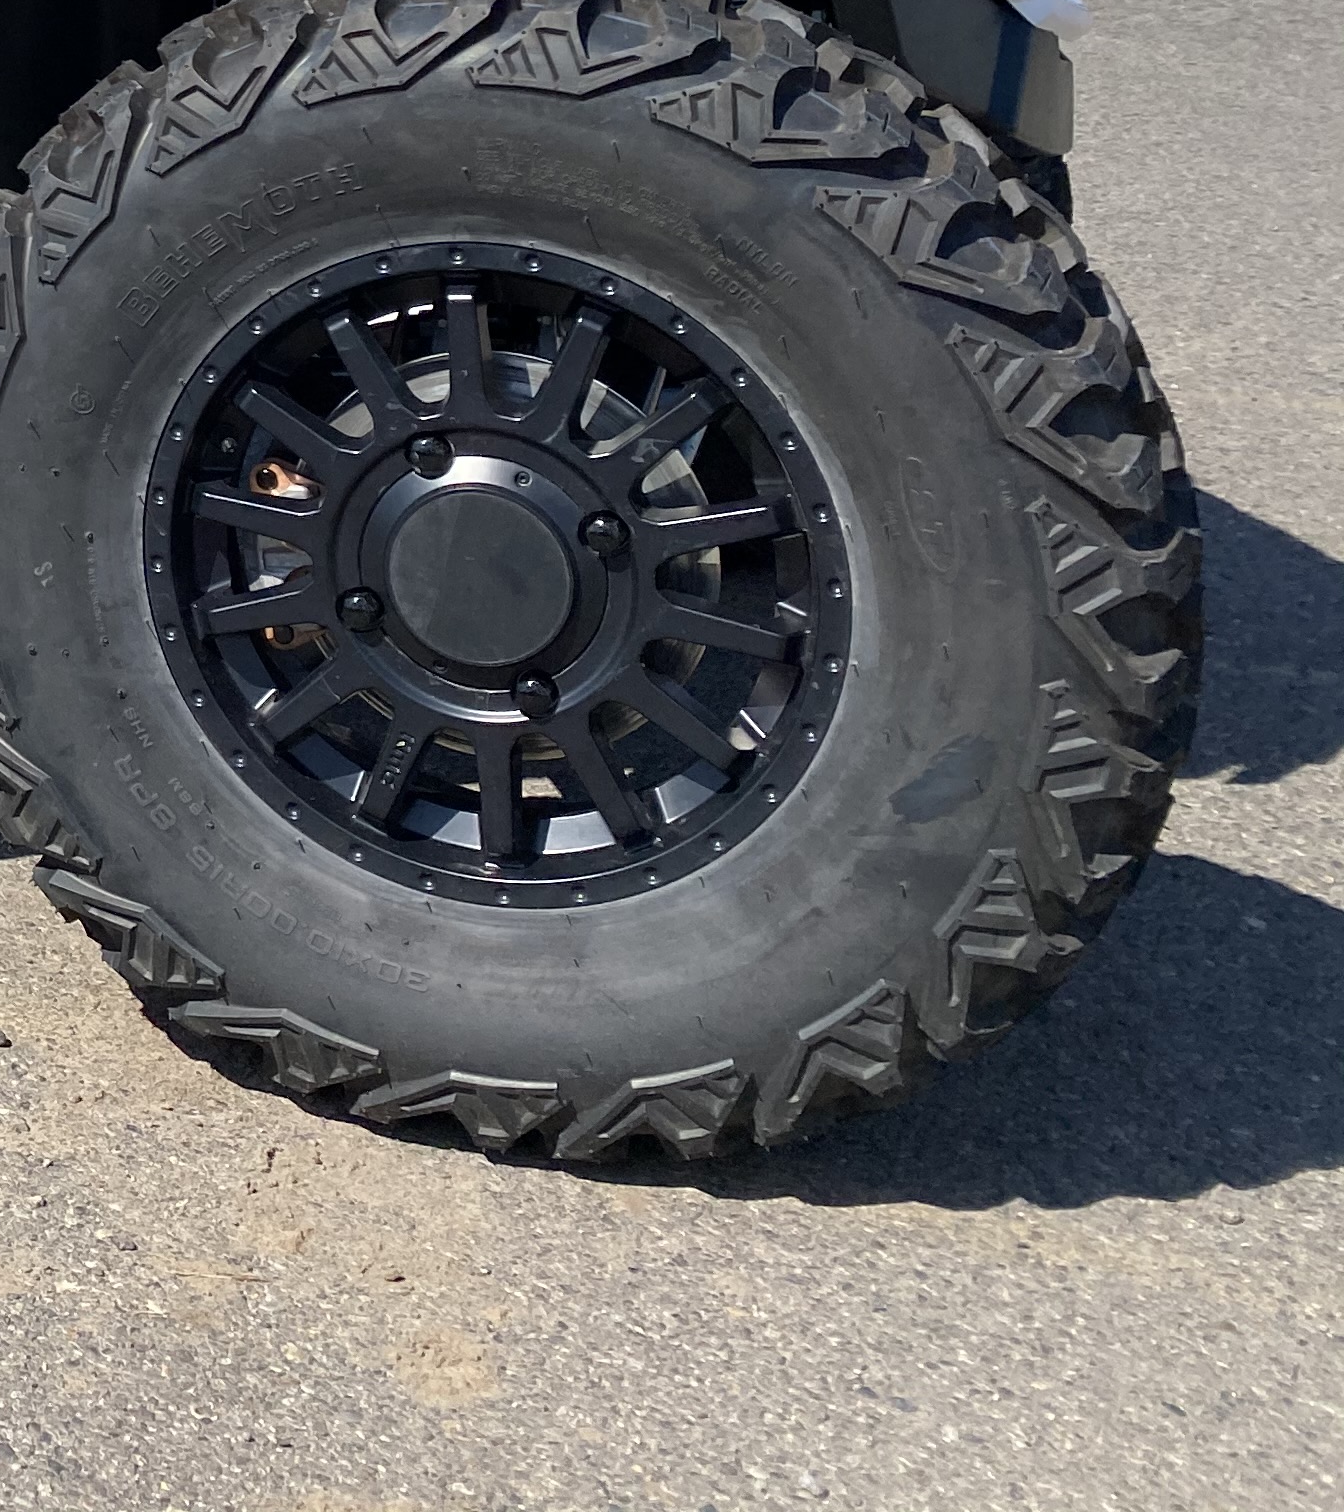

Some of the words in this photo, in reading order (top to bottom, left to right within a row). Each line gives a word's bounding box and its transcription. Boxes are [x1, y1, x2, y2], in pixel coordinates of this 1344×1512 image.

[117, 162, 366, 327] BEHEMOTH
[737, 235, 800, 287] NYLON
[704, 265, 763, 314] RADIAL
[113, 753, 178, 832] 8PR
